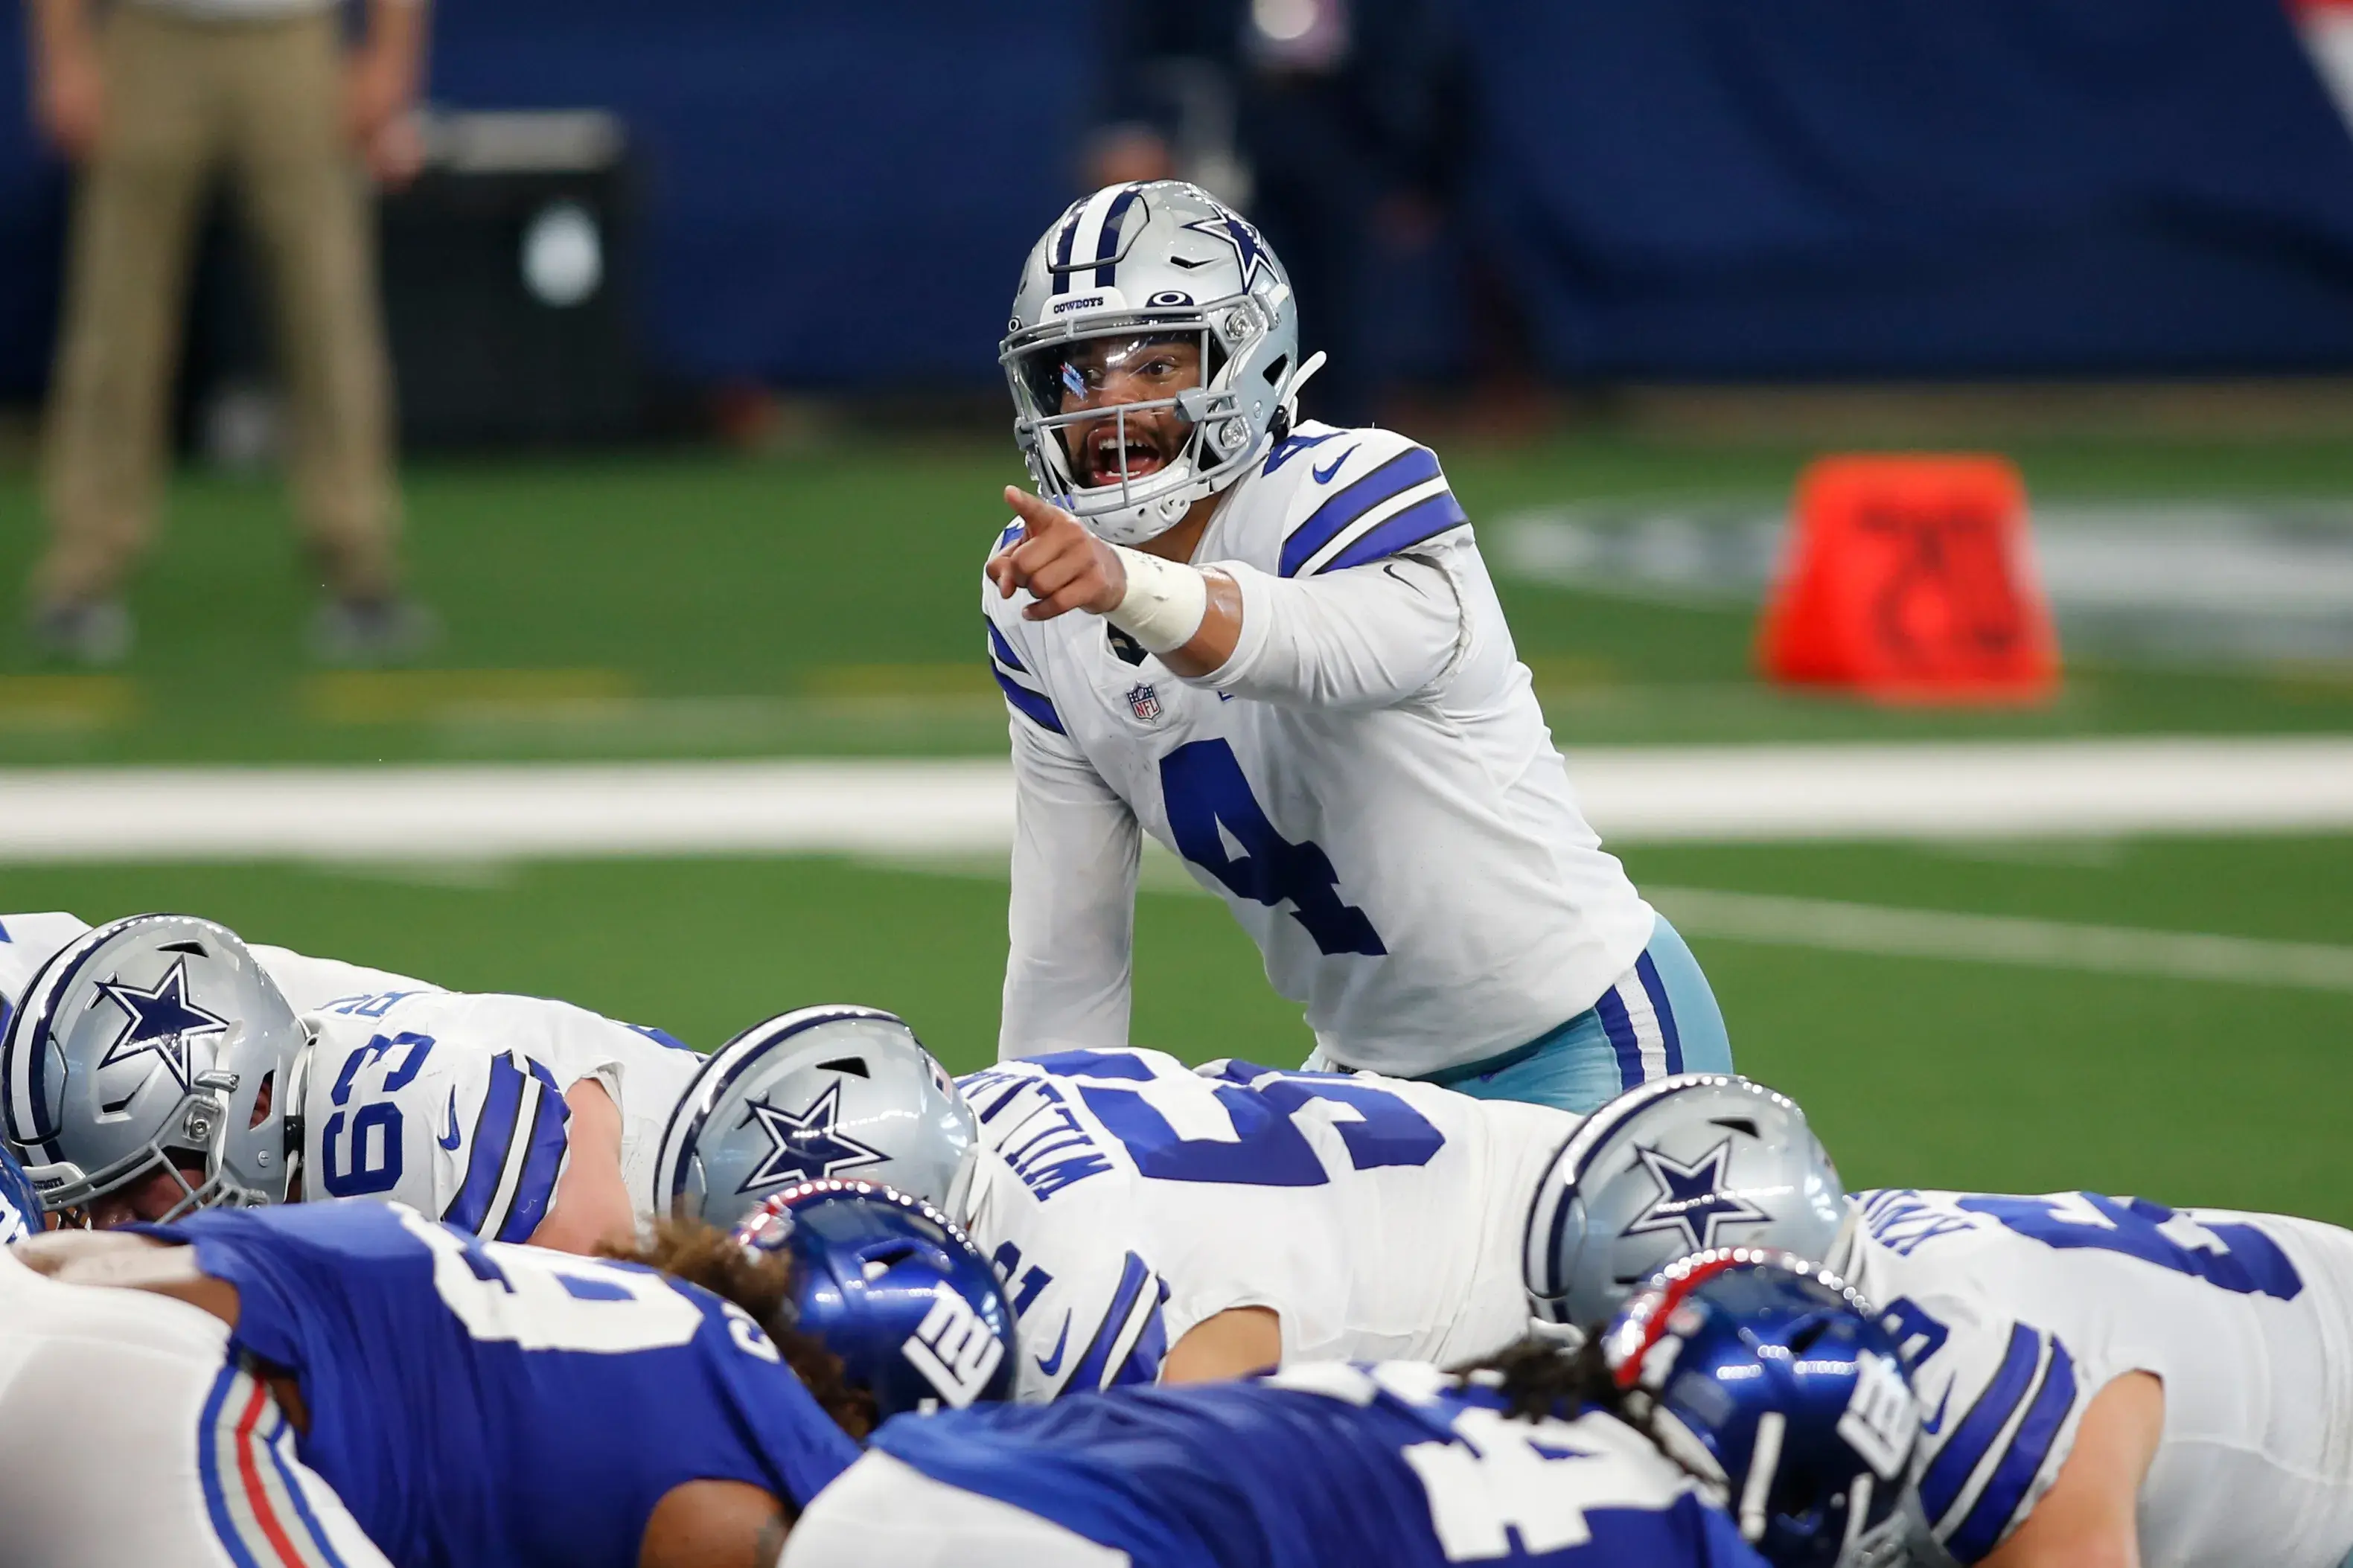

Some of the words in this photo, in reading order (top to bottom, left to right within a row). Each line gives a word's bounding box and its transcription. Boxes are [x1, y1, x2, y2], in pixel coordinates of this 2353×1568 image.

[1053, 297, 1104, 314] COWBOYS
[1134, 700, 1159, 717] NFL
[1160, 737, 1389, 956] 4
[322, 1031, 437, 1198] 63
